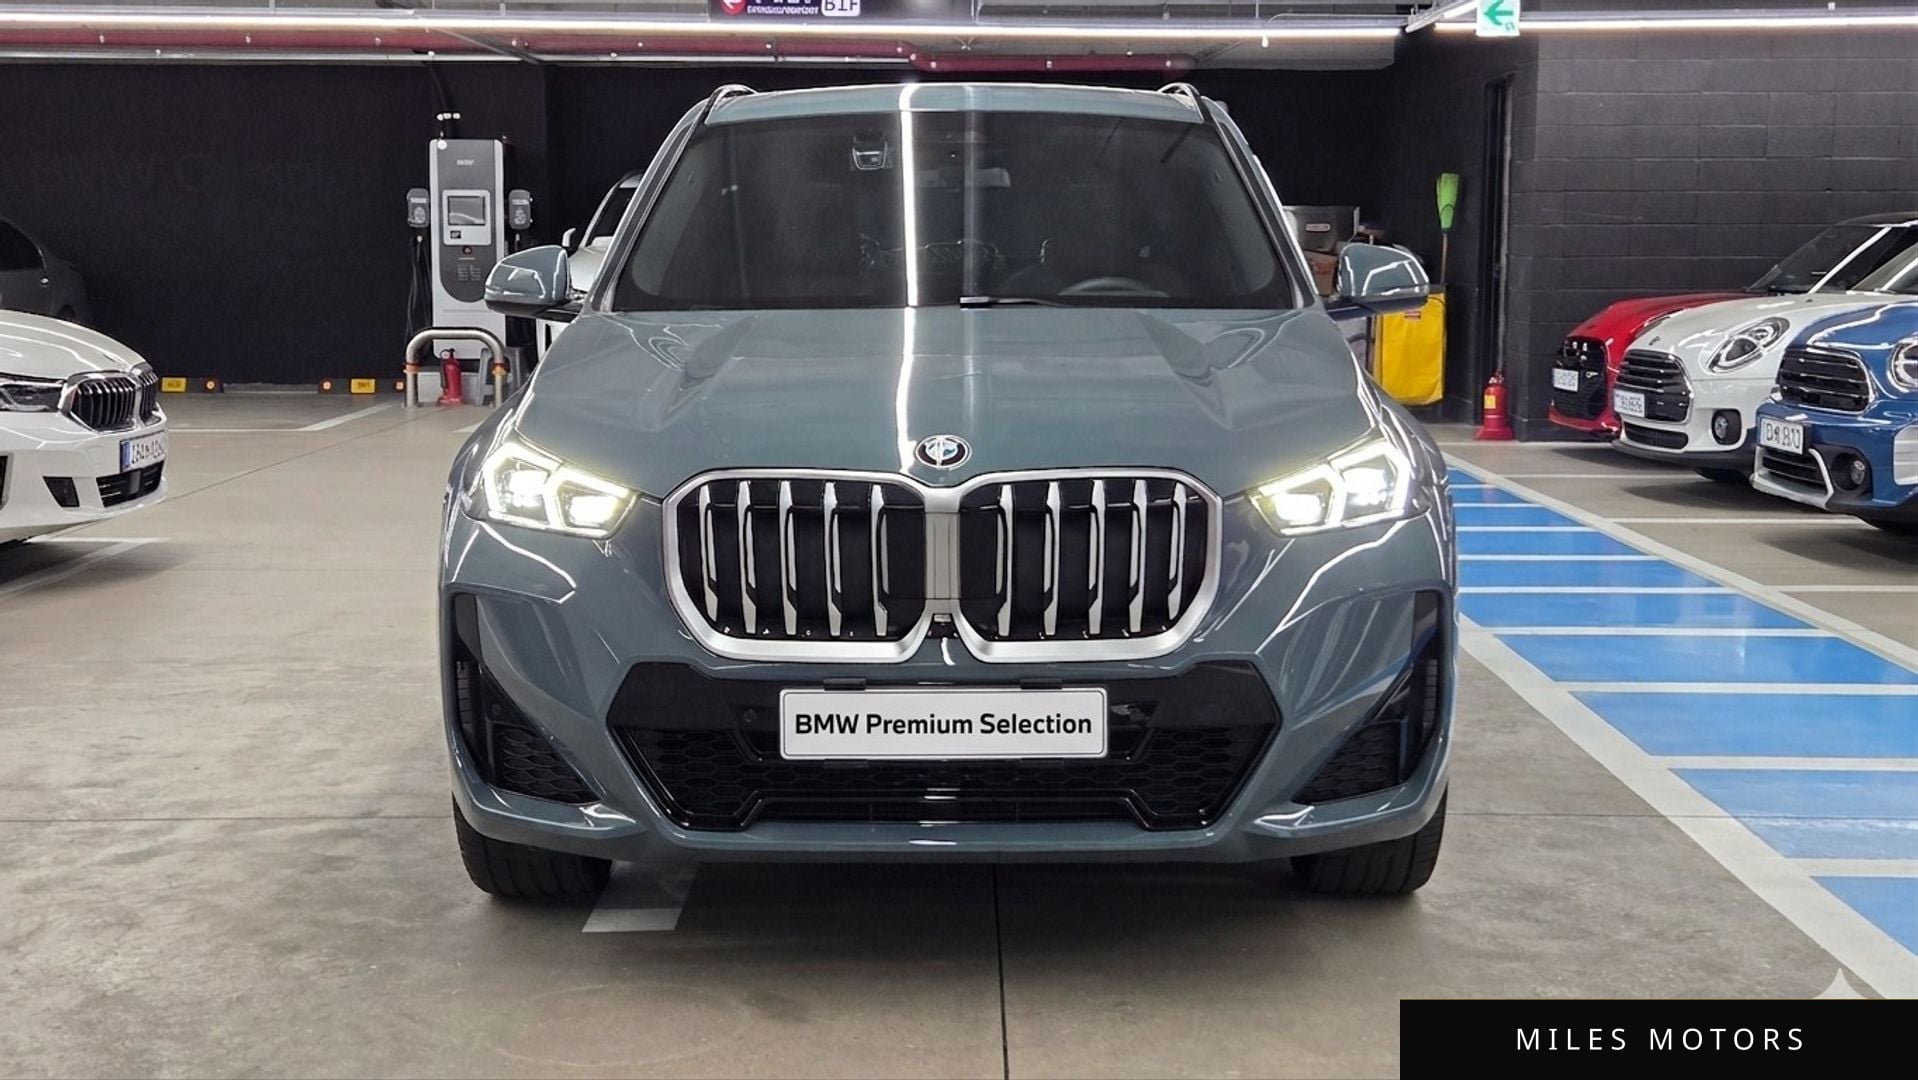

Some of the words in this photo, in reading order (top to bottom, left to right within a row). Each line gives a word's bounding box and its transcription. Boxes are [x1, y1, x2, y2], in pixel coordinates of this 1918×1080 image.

[795, 713, 859, 734] BMW
[866, 713, 973, 734] Premium
[980, 712, 1092, 735] Selection
